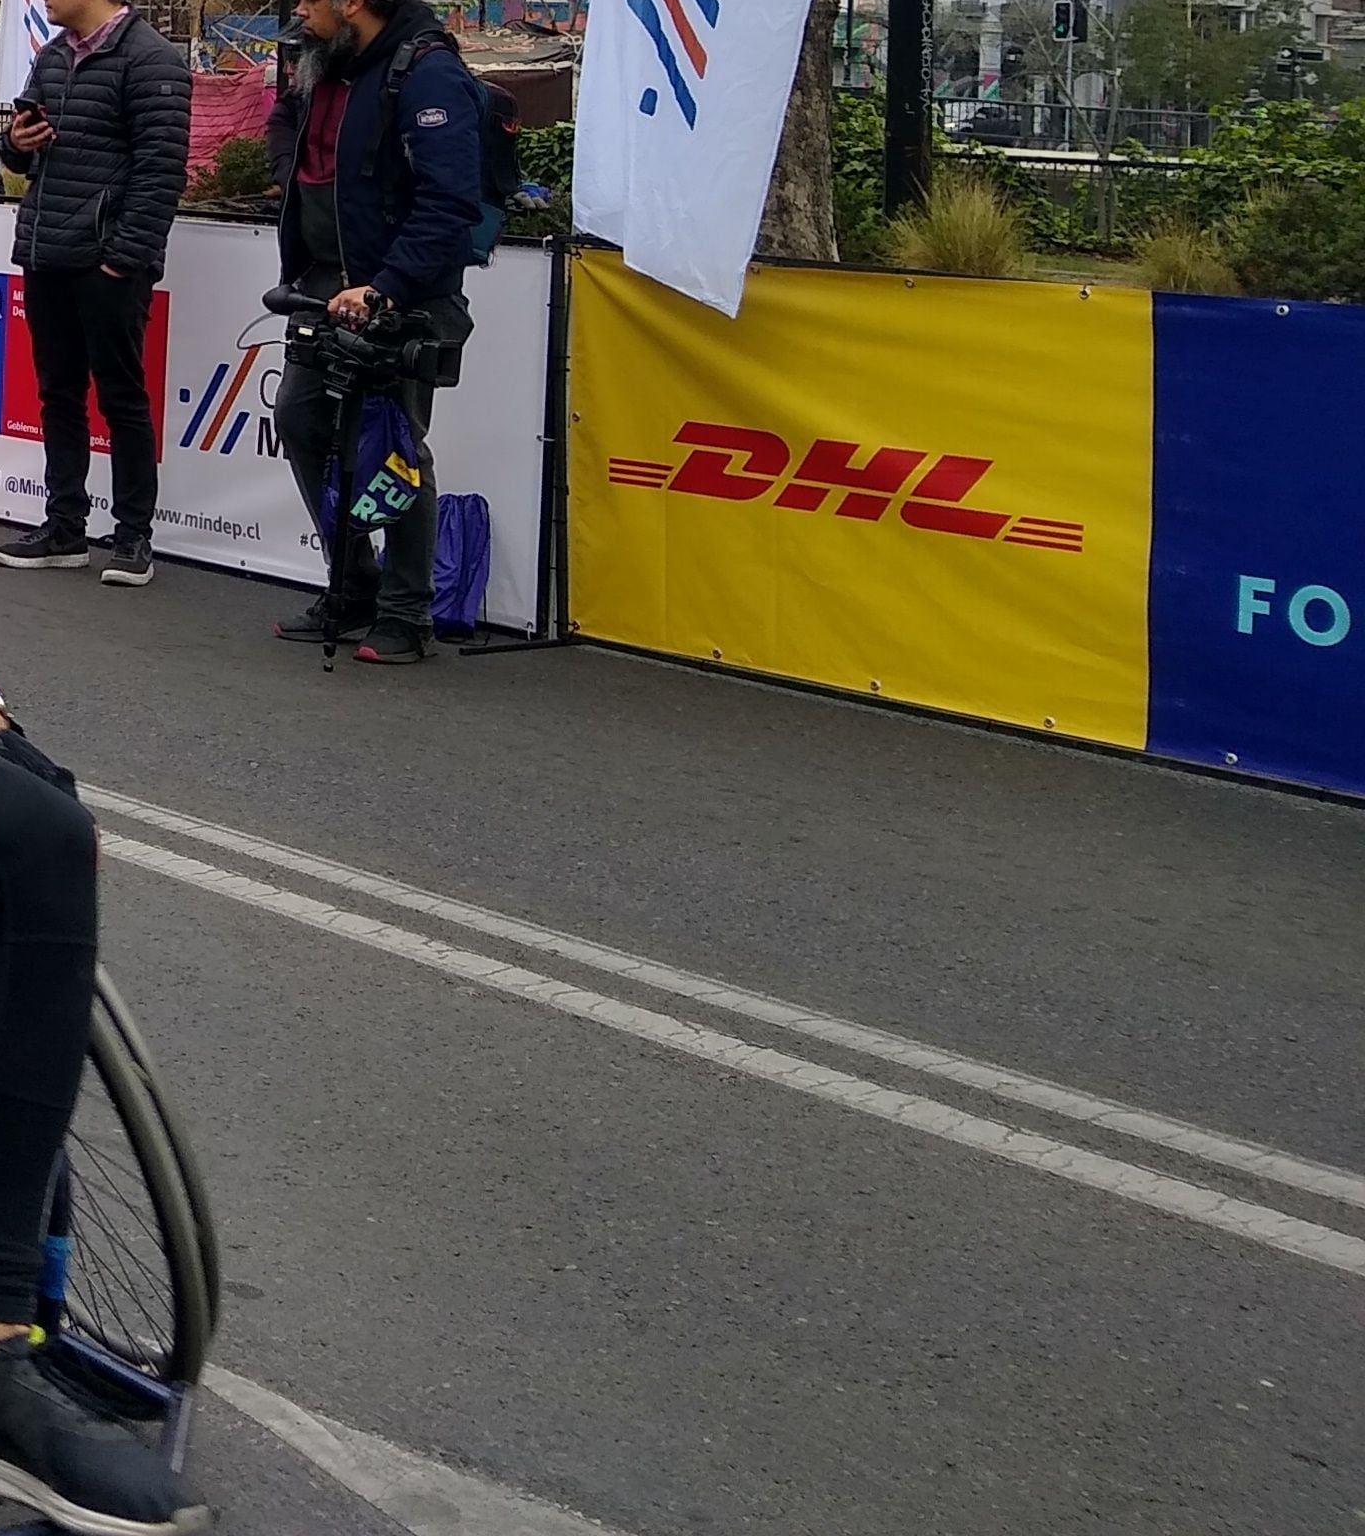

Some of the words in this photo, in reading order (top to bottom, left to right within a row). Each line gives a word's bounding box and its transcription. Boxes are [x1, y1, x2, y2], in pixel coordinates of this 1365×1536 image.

[6, 420, 39, 434] Gobierno
[668, 420, 1013, 540] DHL
[1236, 574, 1352, 648] FO
